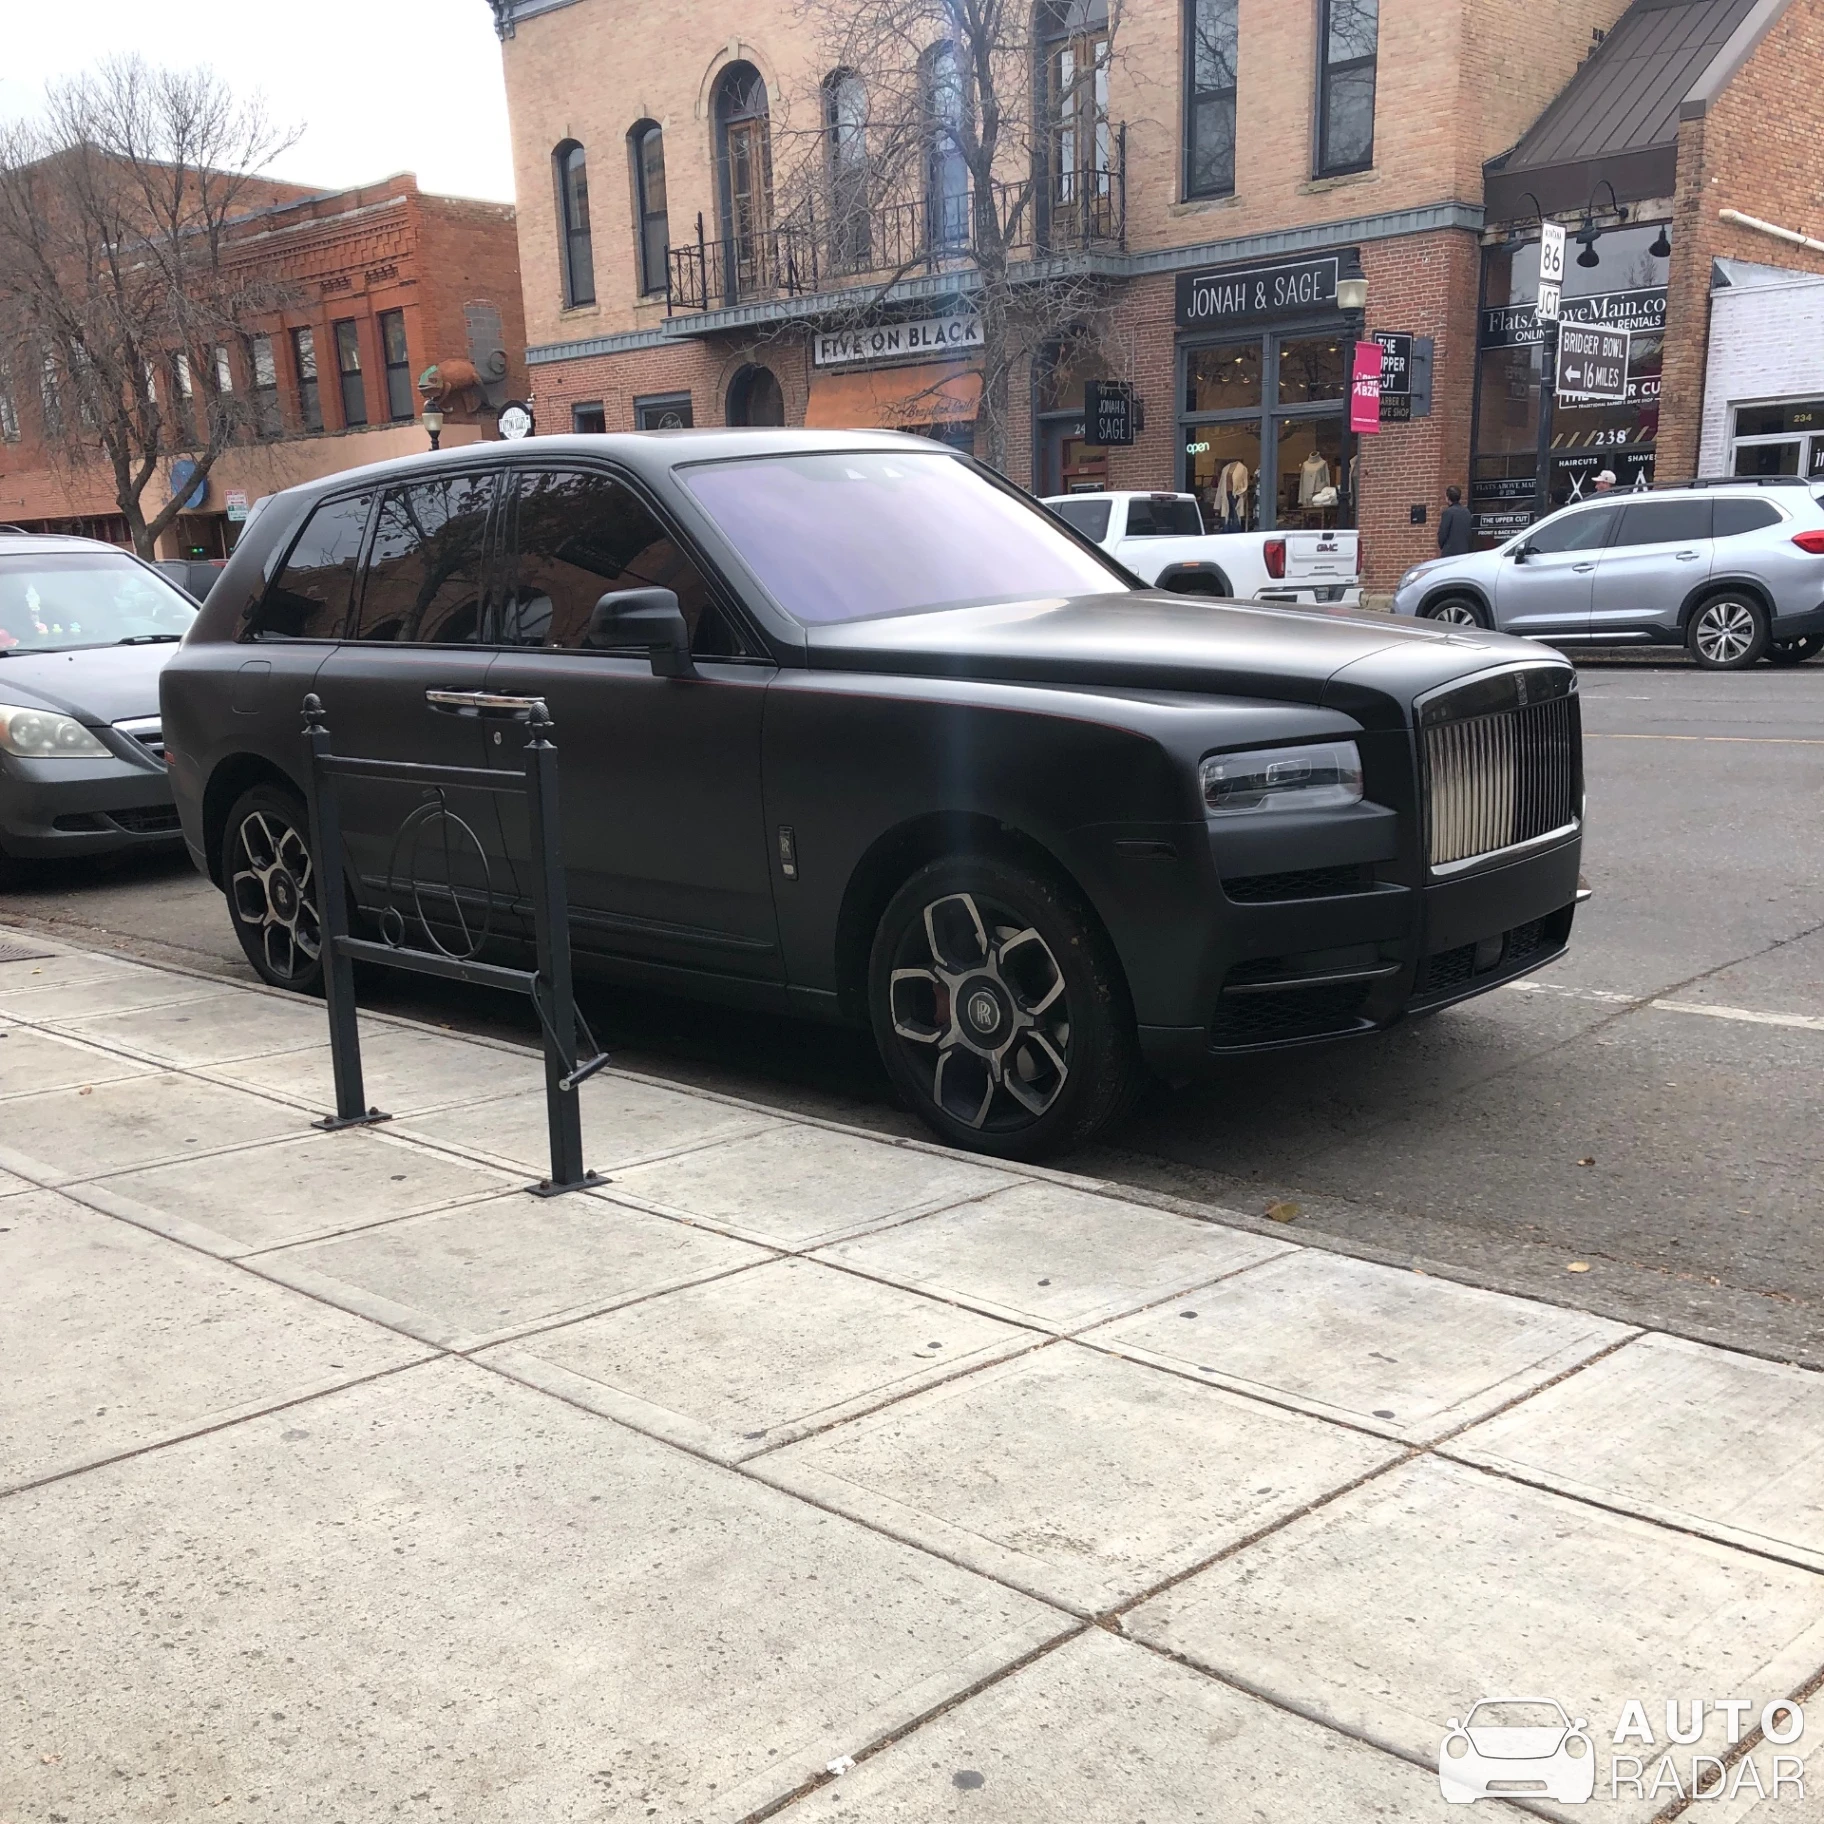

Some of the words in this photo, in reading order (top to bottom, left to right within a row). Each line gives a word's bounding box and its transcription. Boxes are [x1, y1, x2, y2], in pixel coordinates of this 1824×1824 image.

[1543, 243, 1560, 273] 86
[1187, 282, 1246, 318] JONAH
[1254, 281, 1268, 310] &
[1274, 271, 1323, 306] SAGE
[1539, 289, 1559, 316] JCT
[1489, 296, 1666, 332] FlatsAoveMain.co
[1617, 314, 1662, 330] RENTALS
[821, 334, 864, 359] FIVE
[871, 330, 900, 351] ON
[908, 321, 977, 348] BLACK
[1378, 338, 1397, 354] THE
[1563, 331, 1600, 357] BRIDGER
[1602, 336, 1625, 359] BOWL
[1583, 361, 1594, 389] 16
[1595, 367, 1620, 388] MILES
[1361, 385, 1380, 398] BZN
[1098, 399, 1120, 414] JONAH
[1120, 400, 1126, 414] &
[1380, 396, 1399, 407] ARBER
[1793, 413, 1813, 423] 234
[1098, 417, 1126, 440] SAGE
[1595, 430, 1627, 446] 238
[1186, 441, 1210, 455] open
[1558, 457, 1598, 467] HAIRCUTS
[1495, 516, 1514, 524] UPPER
[1515, 515, 1528, 523] CUT
[1316, 543, 1339, 552] GMC
